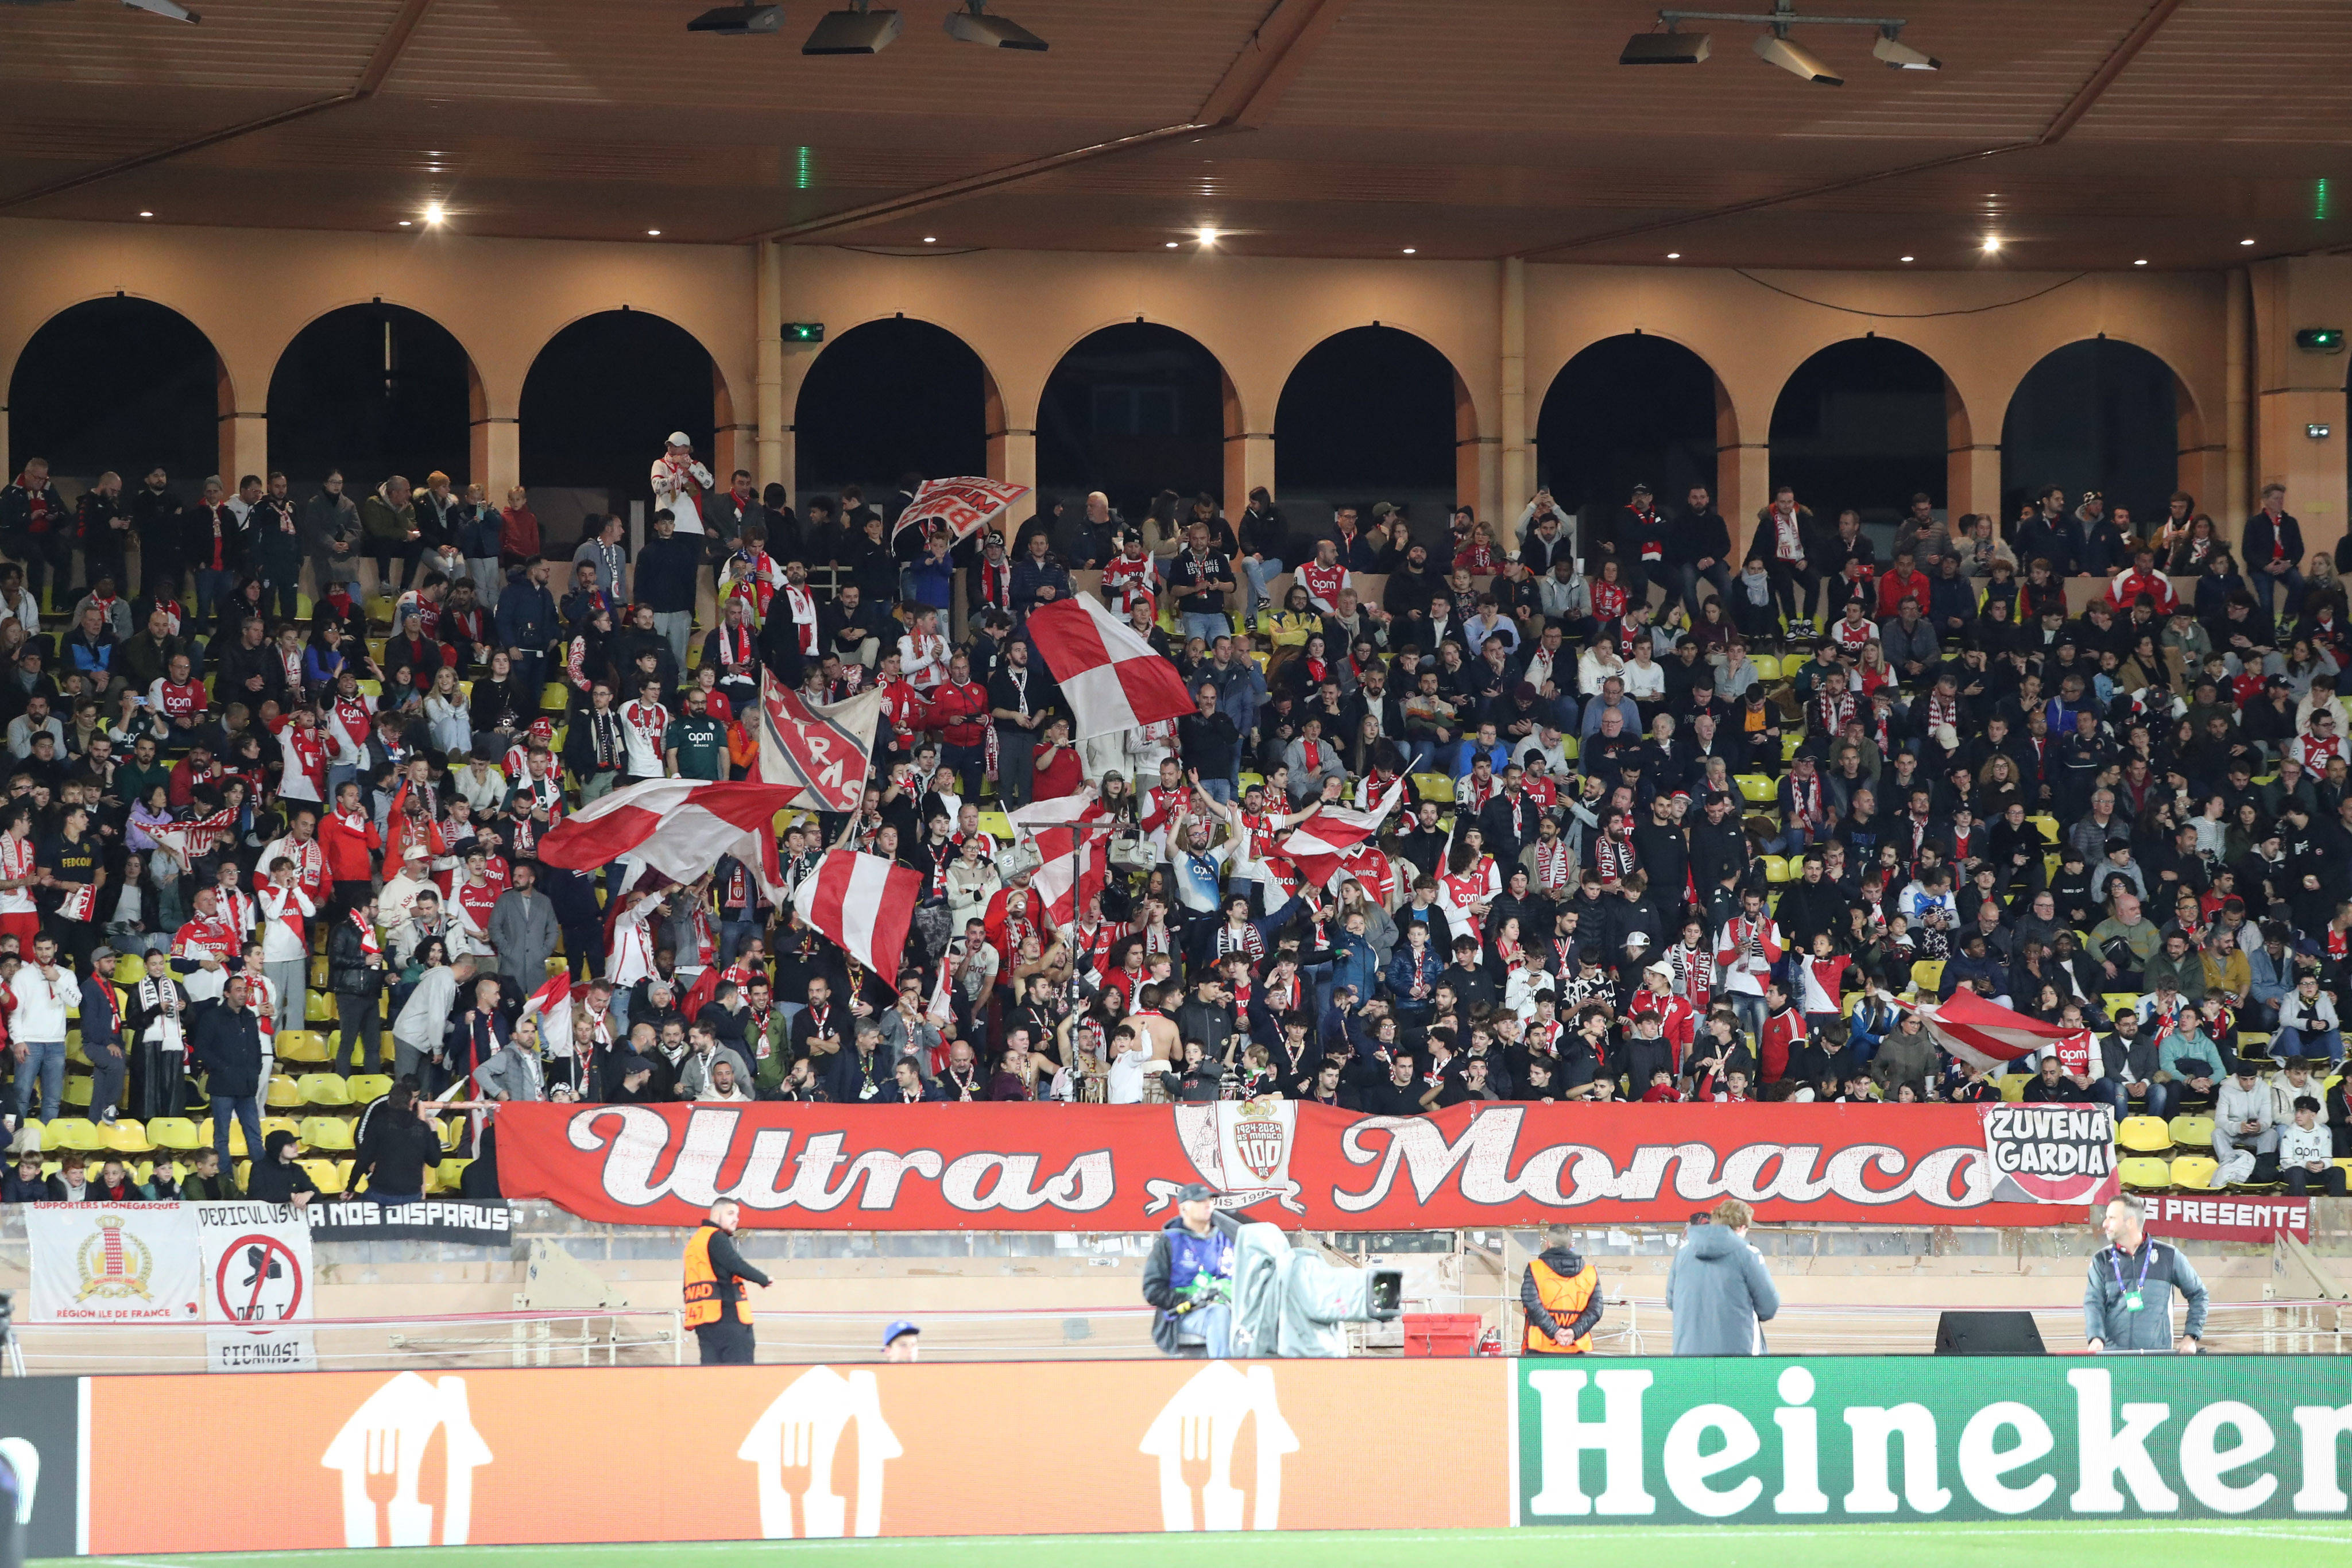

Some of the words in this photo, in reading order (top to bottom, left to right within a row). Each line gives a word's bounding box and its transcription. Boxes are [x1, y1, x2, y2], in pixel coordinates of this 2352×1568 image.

[1186, 559, 1218, 568] LONDALE
[1312, 579, 1336, 590] apm
[167, 697, 192, 709] apm
[632, 726, 661, 737] FEDOM
[688, 732, 713, 744] apm
[466, 900, 494, 908] MONACO
[1459, 893, 1479, 907] apm
[196, 941, 229, 951] vizzavi
[2060, 1048, 2087, 1061] apm
[1993, 1108, 2108, 1143] ZUVENA
[1237, 1140, 1282, 1167] 100
[2295, 1145, 2320, 1159] apm
[567, 1105, 1116, 1213] Ultras
[1332, 1105, 1994, 1208] Monaco
[1997, 1143, 2106, 1175] GARDIA
[33, 1201, 99, 1210] SUPPORTERS
[307, 1203, 325, 1226] A
[329, 1202, 381, 1226] NOS
[386, 1202, 509, 1230] DISPARUS
[2165, 1199, 2307, 1229] PRESENTS
[56, 1308, 95, 1318] RÉGION
[115, 1310, 129, 1318] DE
[132, 1309, 171, 1318] FRANCE
[1527, 1365, 2352, 1516] Heineken
